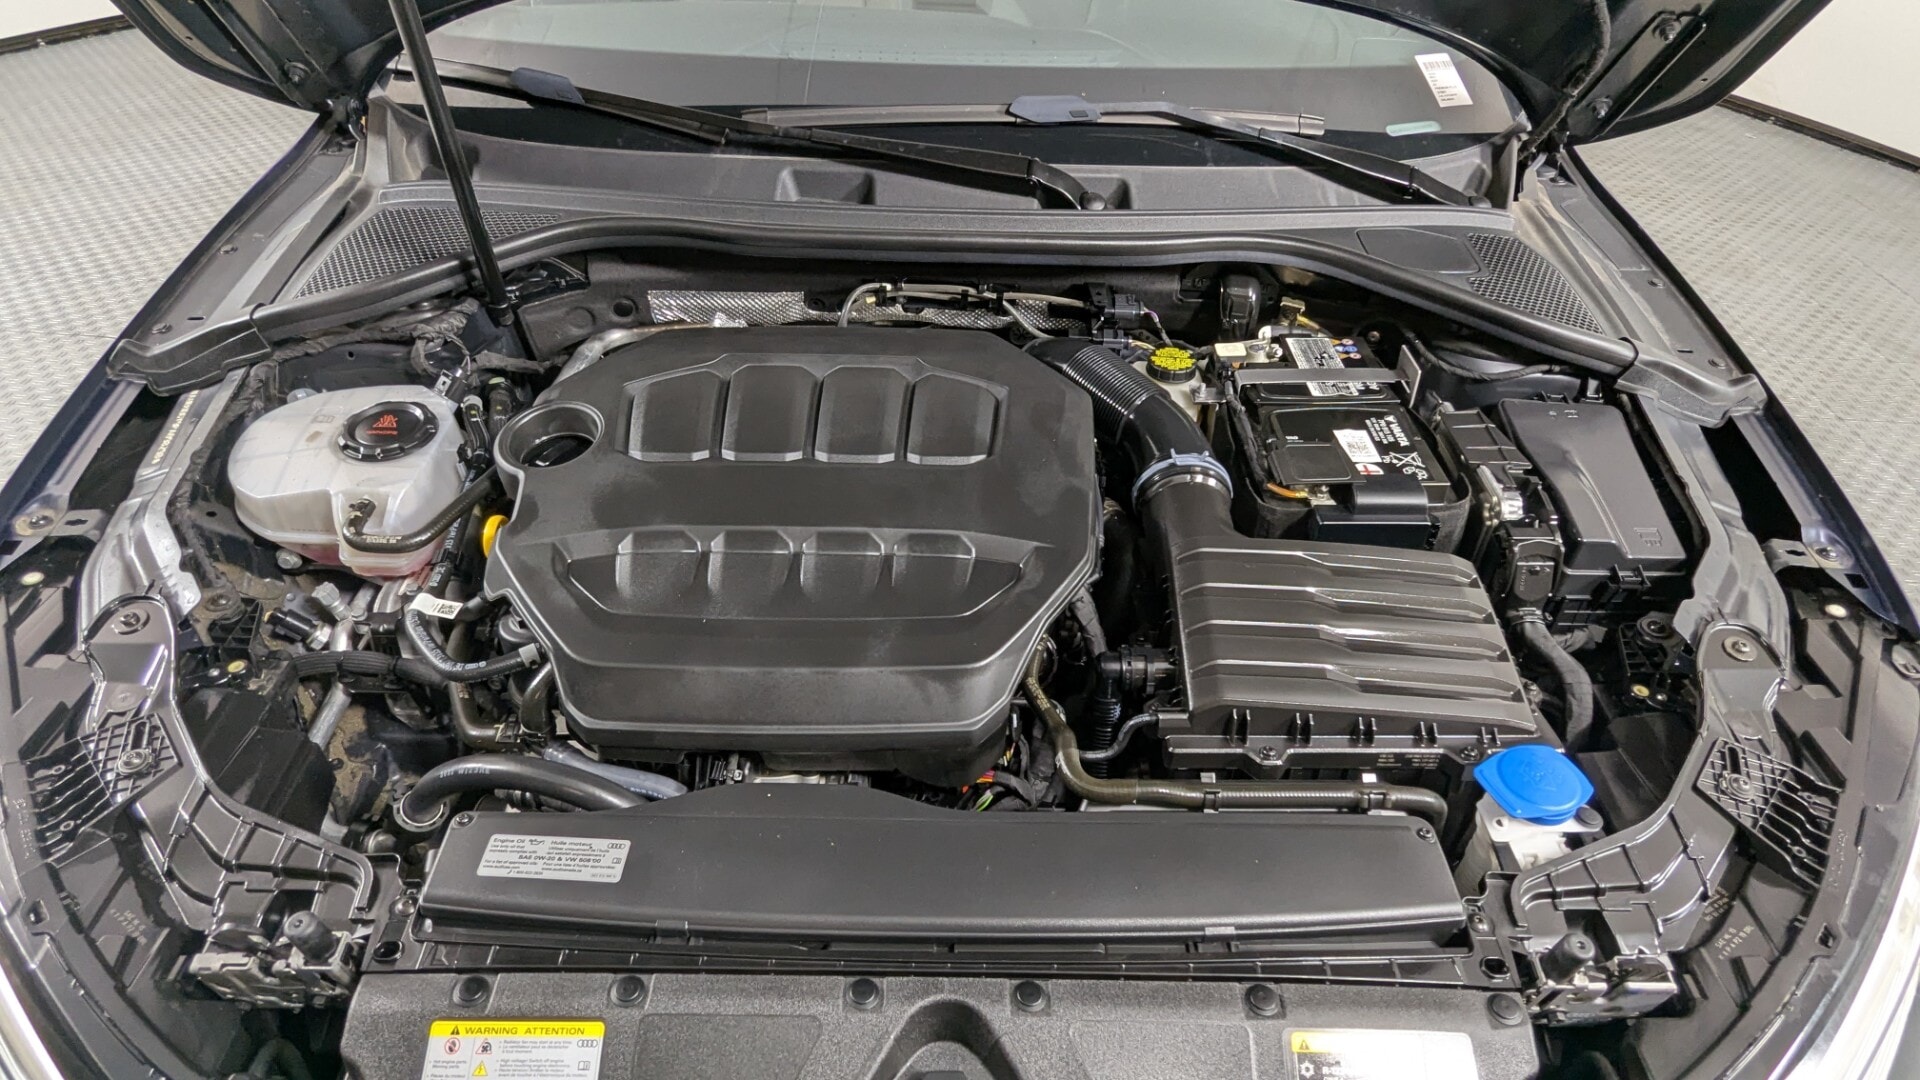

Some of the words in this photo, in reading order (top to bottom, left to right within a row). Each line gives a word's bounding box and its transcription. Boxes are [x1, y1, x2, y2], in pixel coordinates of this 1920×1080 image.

[1390, 423, 1410, 446] VARTA
[464, 1027, 518, 1035] WARNING
[524, 1027, 585, 1035] ATTENTION
